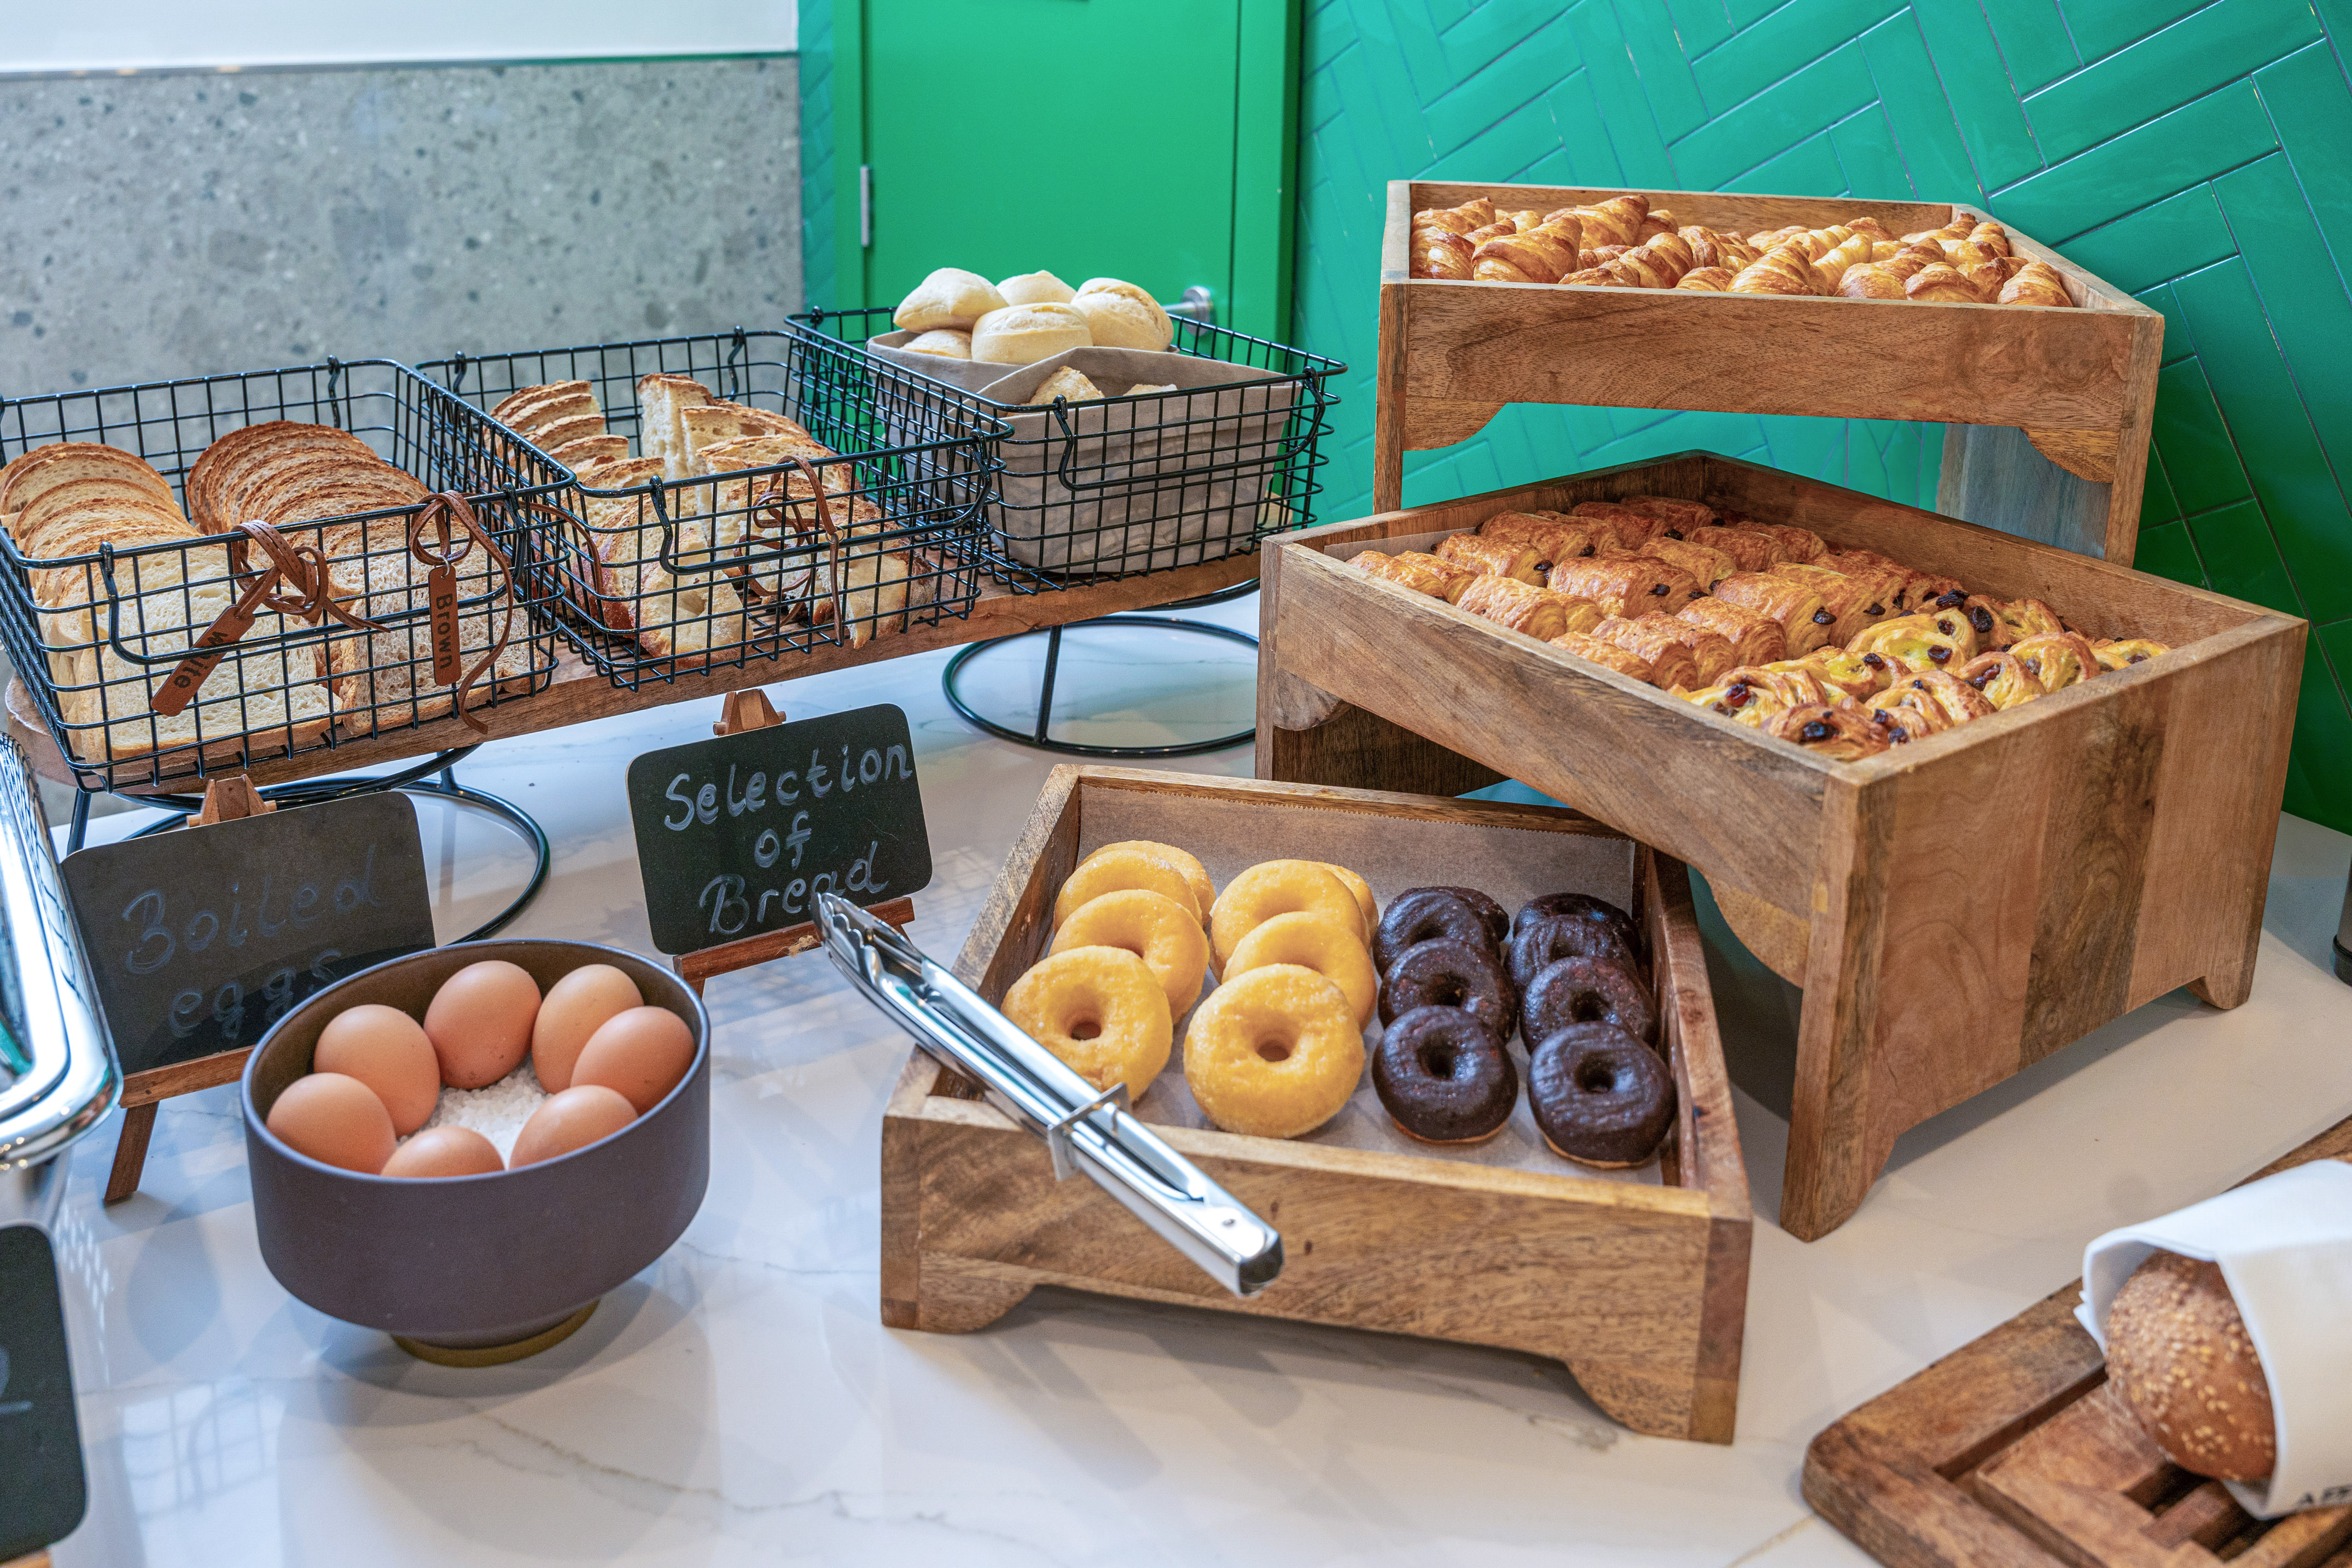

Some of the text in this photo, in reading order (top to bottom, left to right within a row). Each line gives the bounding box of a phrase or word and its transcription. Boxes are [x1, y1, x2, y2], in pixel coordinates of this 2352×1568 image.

[174, 632, 228, 689] wite
[436, 593, 453, 669] Brown
[664, 743, 913, 831] Selection
[754, 810, 812, 869] of
[122, 843, 387, 975] Boiled
[700, 841, 889, 935] Bread
